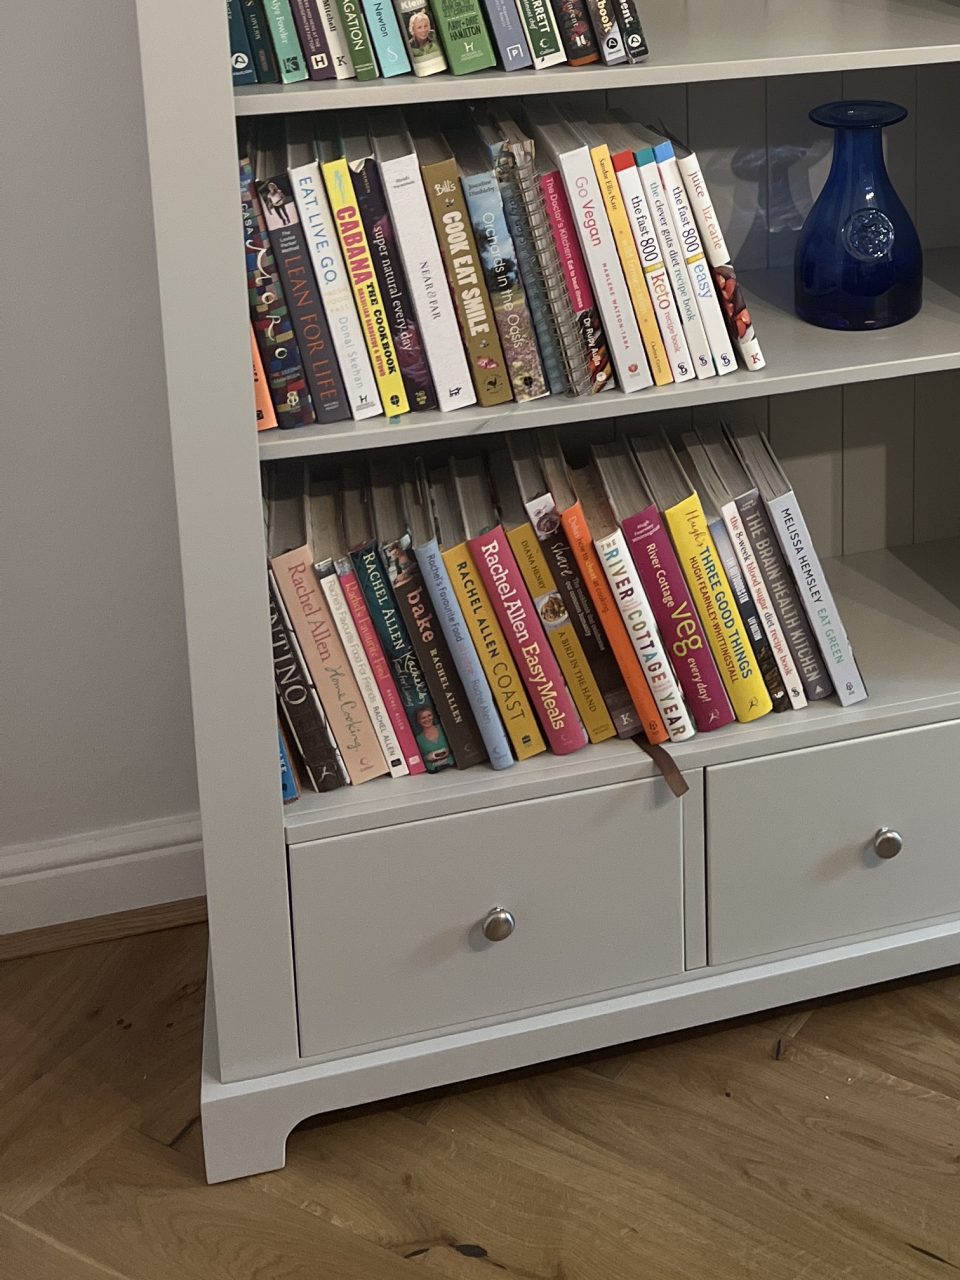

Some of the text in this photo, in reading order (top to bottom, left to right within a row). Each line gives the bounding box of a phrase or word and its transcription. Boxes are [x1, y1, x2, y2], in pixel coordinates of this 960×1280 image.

[336, 205, 374, 285] CABANA
[575, 176, 602, 247] Go Vegan
[631, 195, 659, 262] the fast 800
[442, 211, 485, 337] COOK EAT SMILE
[651, 272, 671, 310] keto
[694, 264, 712, 299] easy
[283, 254, 338, 401] LEAN FOR LIFE
[747, 512, 820, 682] THE BRAIN HEALTH KITCHEN
[780, 508, 824, 603] MELISSA HEMSLEY
[407, 588, 434, 643] bake
[456, 561, 526, 721] RACHEL ALLEN COAST
[481, 539, 565, 731] Rachel Allen Easy Meals
[603, 547, 635, 601] RIVER
[627, 609, 667, 684] COTTAGE
[660, 692, 687, 737] YEAR
[671, 601, 703, 657] Veg
[700, 546, 722, 591] THREE
[714, 592, 733, 630] GOOD
[728, 631, 753, 679] THINGS
